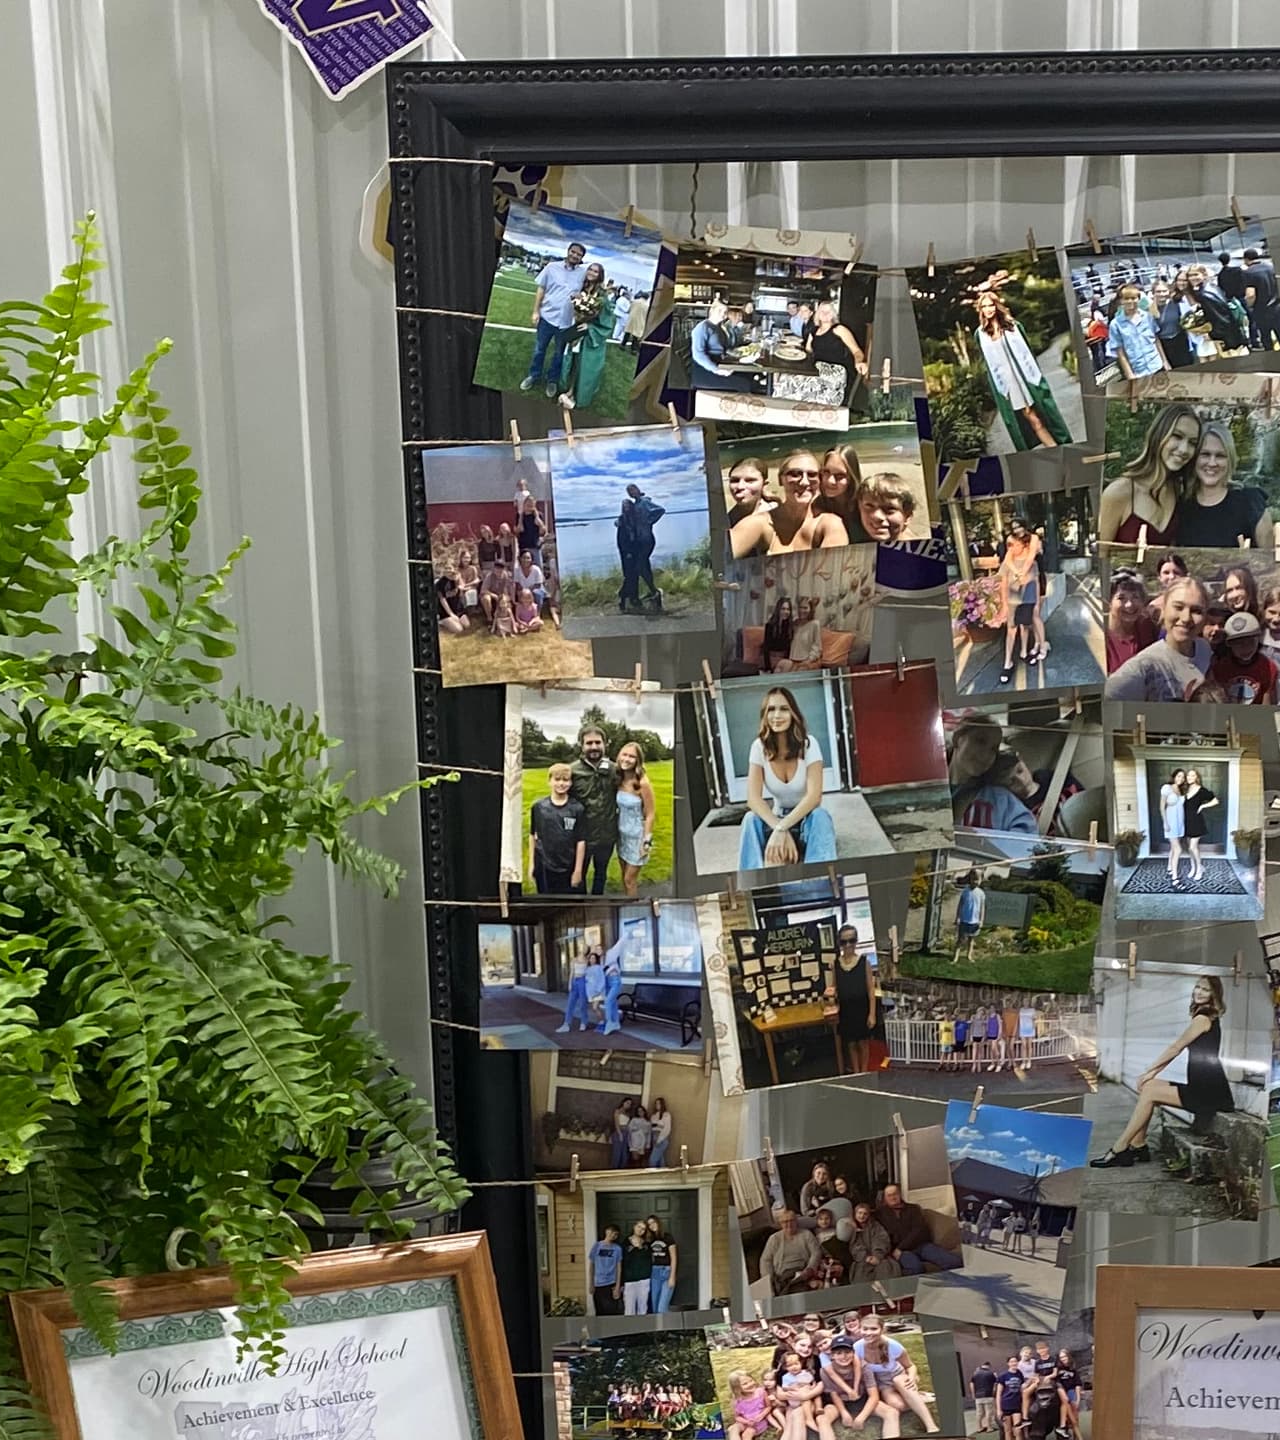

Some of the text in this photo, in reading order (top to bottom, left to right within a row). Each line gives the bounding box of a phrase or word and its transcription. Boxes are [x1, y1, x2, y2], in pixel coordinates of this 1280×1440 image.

[768, 926, 807, 942] AUDREY
[138, 1338, 408, 1399] Woodinville High School
[183, 1389, 376, 1430] Achievement & Excellence
